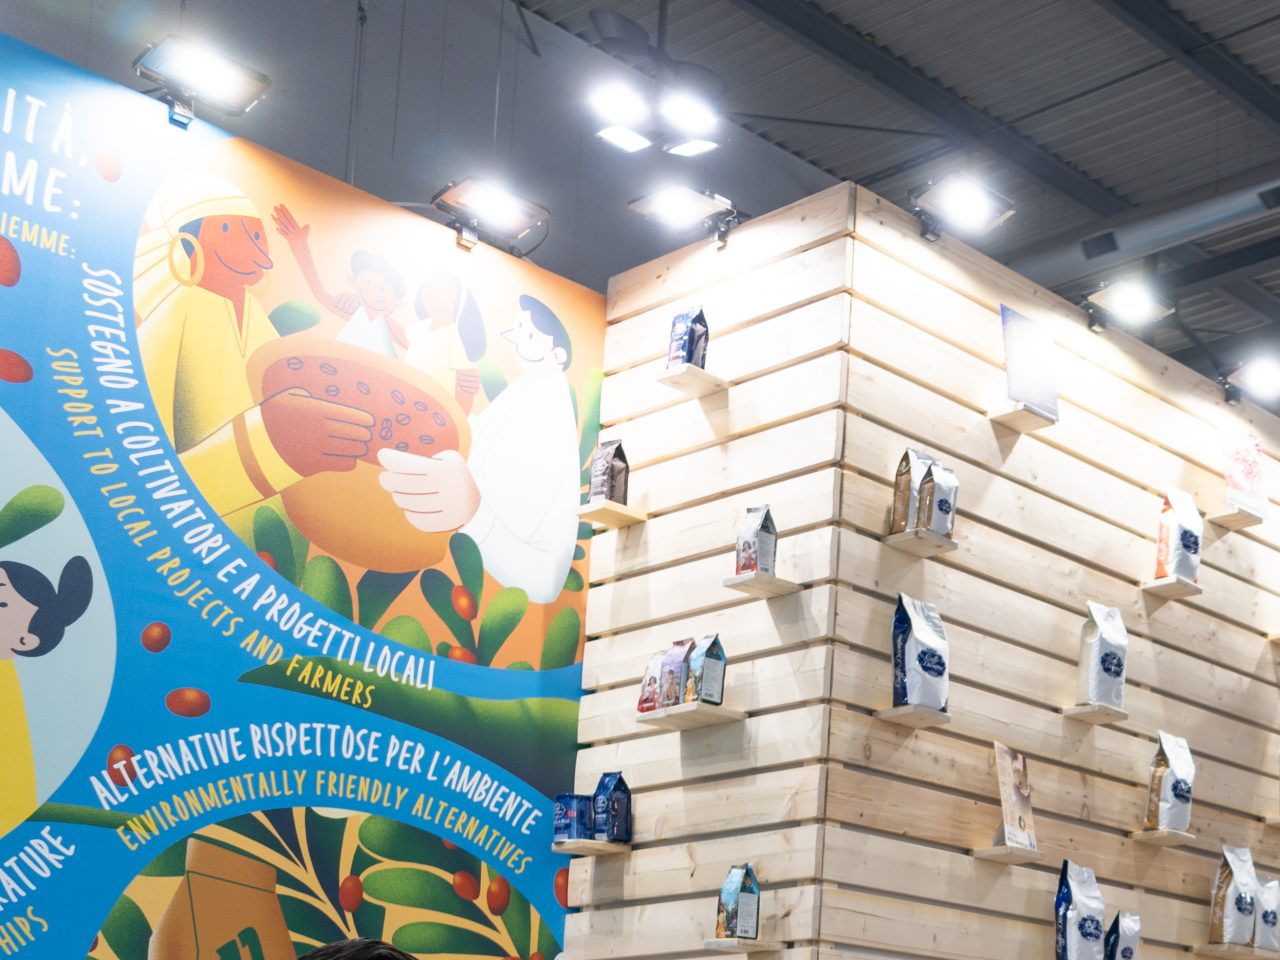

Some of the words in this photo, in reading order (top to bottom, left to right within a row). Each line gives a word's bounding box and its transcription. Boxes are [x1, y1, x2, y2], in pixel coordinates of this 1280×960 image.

[81, 262, 139, 389] SOSTEGNO
[105, 399, 145, 414] A
[46, 347, 104, 438] SUPPORT
[83, 447, 119, 475] TO
[101, 482, 159, 547] LOCAL
[147, 546, 244, 637] PROJECTS
[240, 629, 285, 667] AND
[285, 654, 376, 710] FARMERS
[116, 420, 230, 566] COLTIVATORI
[216, 557, 248, 583] E
[232, 573, 261, 601] A
[252, 584, 361, 666] PROGETTI
[362, 641, 436, 691] LOCALI
[89, 727, 247, 811] ALTERNATIVE
[249, 722, 382, 763] RISPETTOSE
[385, 735, 425, 774] PER
[427, 750, 543, 835] L'AMBIENTE
[116, 769, 308, 851] ENVIRONMENTALLY
[315, 769, 409, 810] FRIENDLY
[411, 793, 533, 875] ALTERNATIVES
